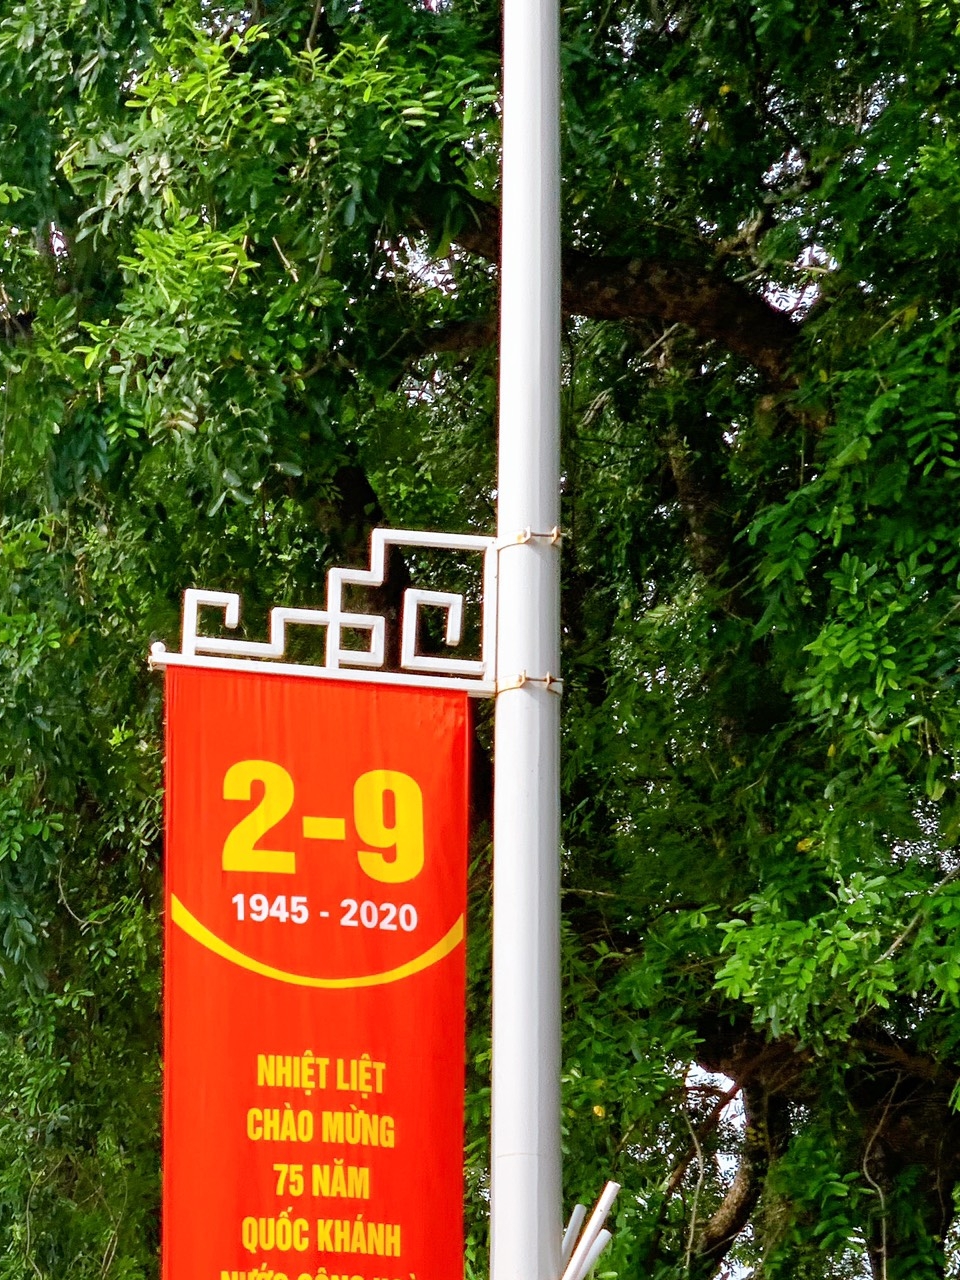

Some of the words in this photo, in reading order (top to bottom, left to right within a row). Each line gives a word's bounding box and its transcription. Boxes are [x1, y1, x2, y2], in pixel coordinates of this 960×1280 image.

[222, 759, 425, 884] 2-9
[231, 893, 310, 925] 1945
[339, 898, 418, 932] 2020
[257, 1049, 330, 1096] NHIỆT
[336, 1053, 386, 1099] LIỆT
[246, 1102, 314, 1143] CHÀO
[321, 1104, 395, 1148] MỪNG
[273, 1163, 305, 1197] 75
[311, 1158, 370, 1200] NĂM
[242, 1206, 310, 1254] QUỐC
[317, 1213, 401, 1257] KHÁNH
